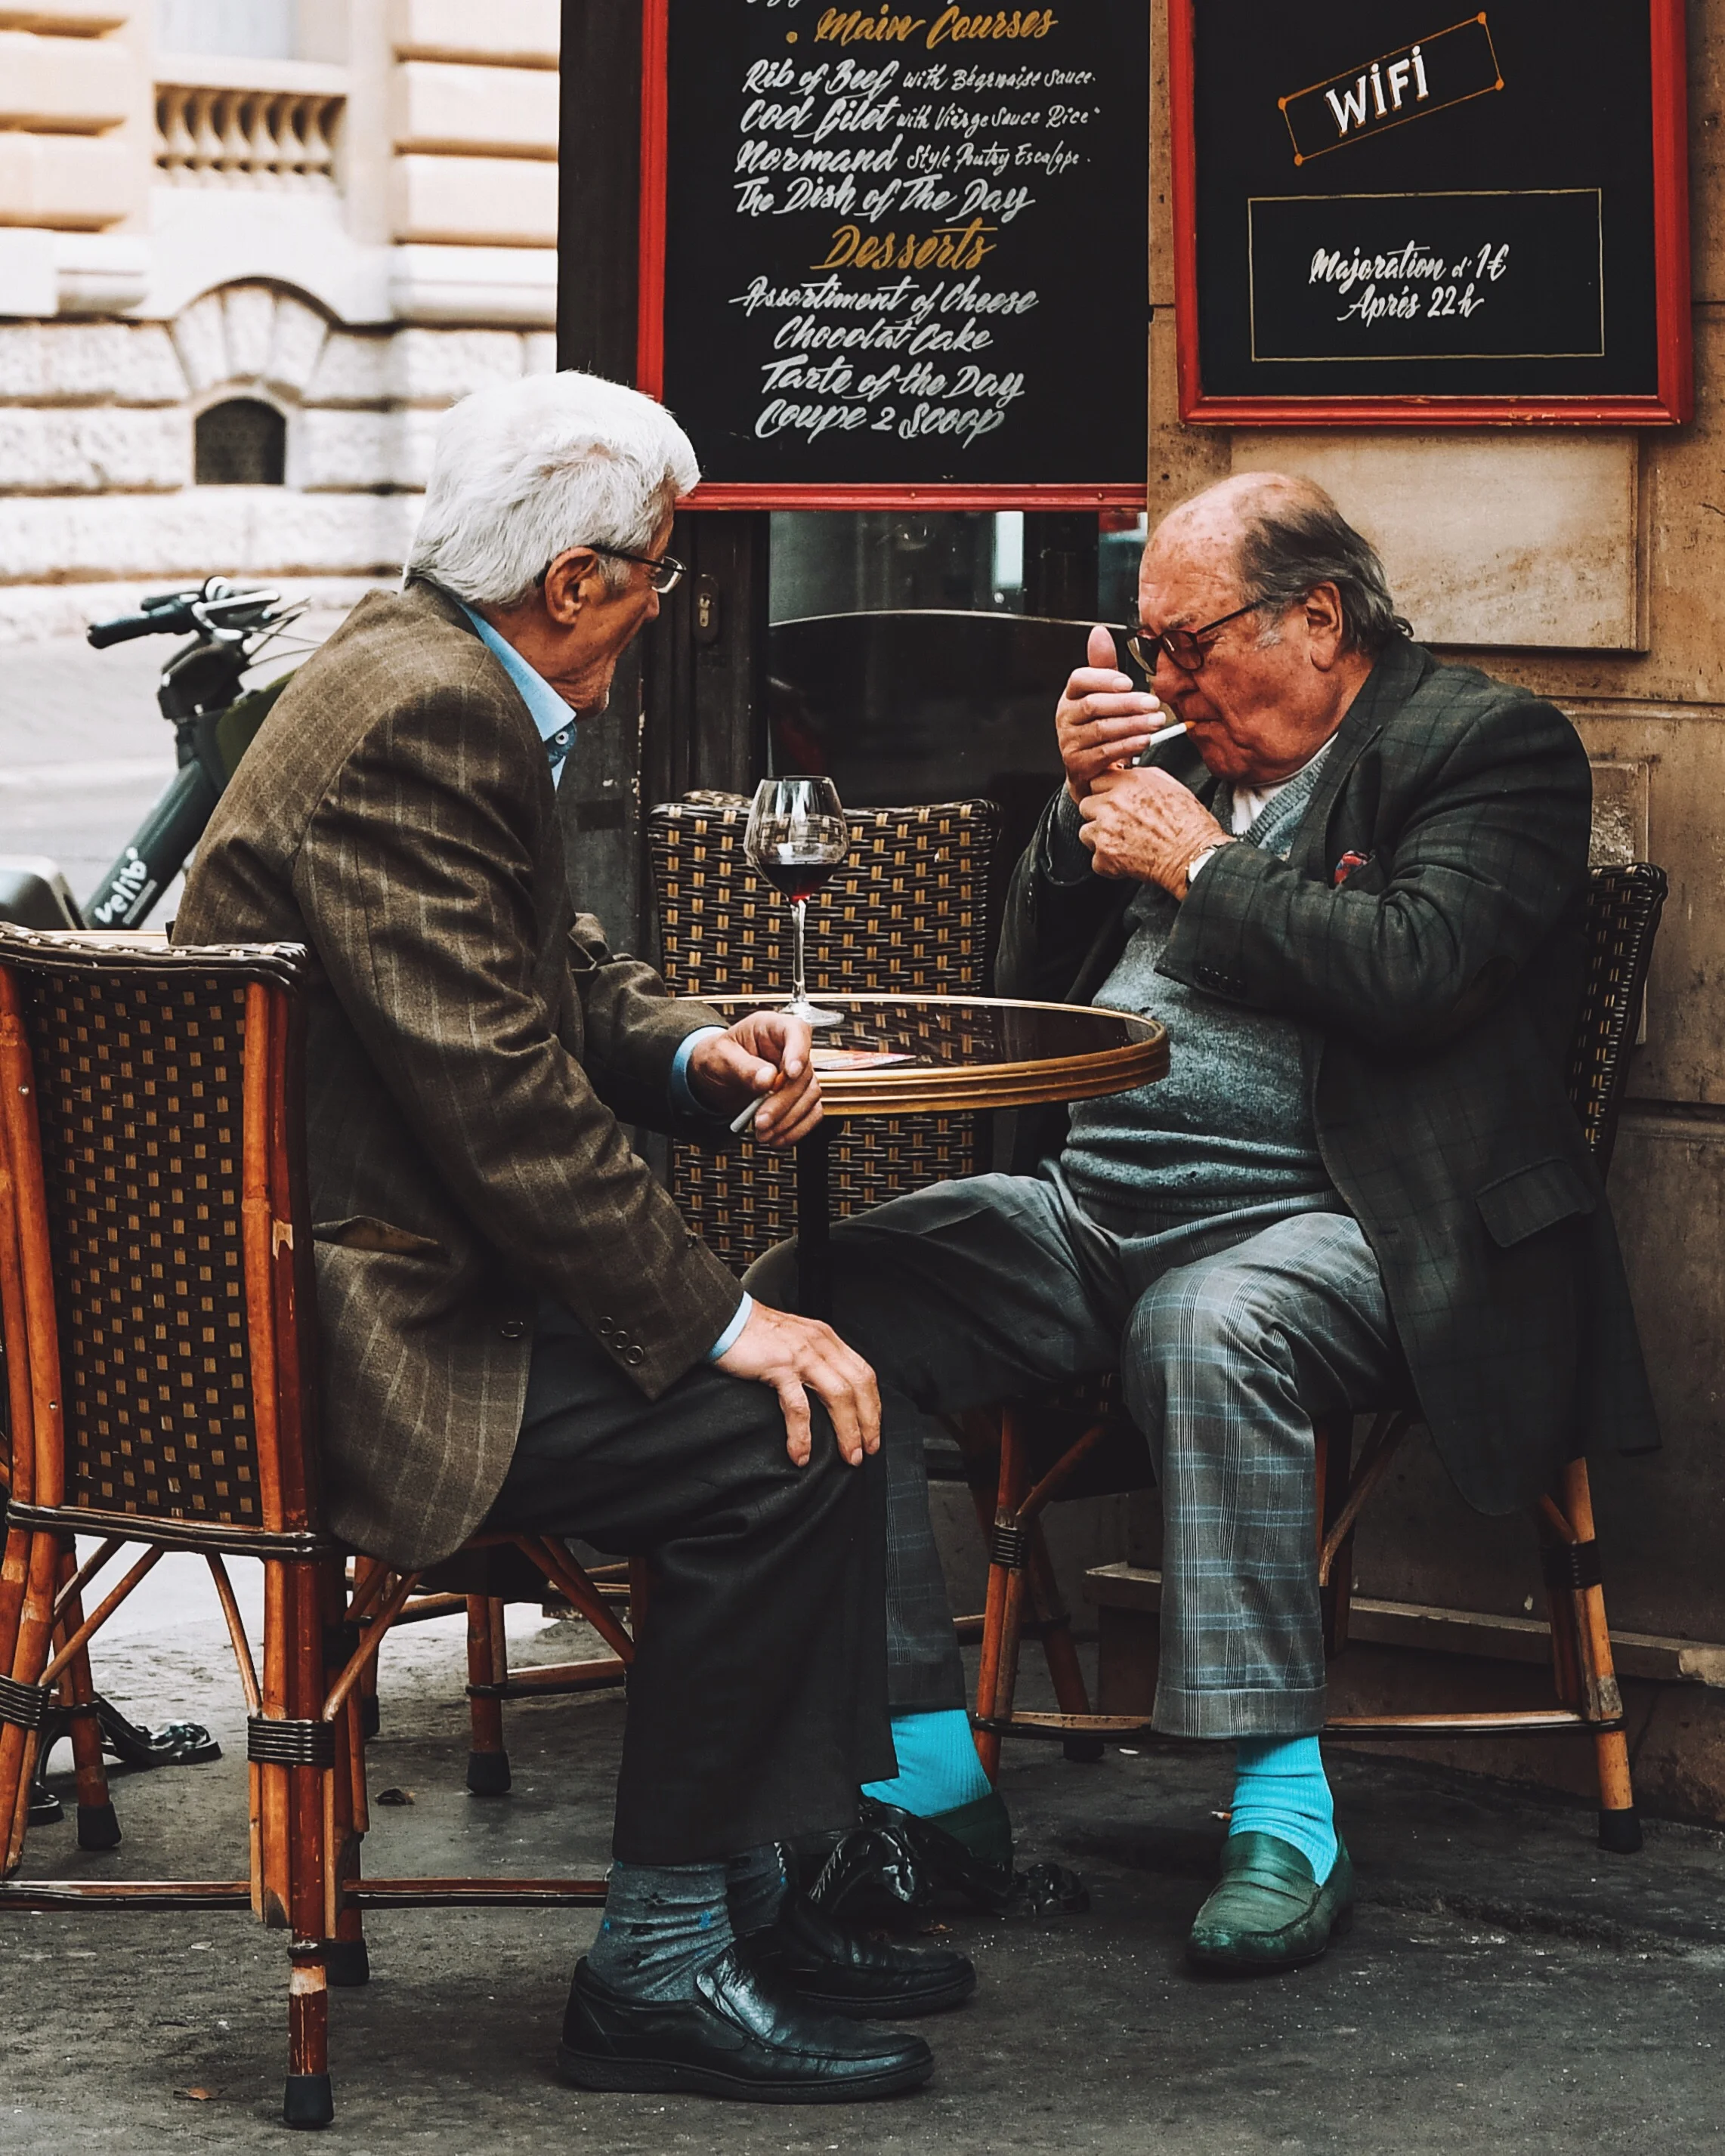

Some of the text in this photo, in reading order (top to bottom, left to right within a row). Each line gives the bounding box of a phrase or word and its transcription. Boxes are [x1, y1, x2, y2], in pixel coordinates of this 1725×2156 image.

[814, 4, 1059, 50] Main Courses
[742, 58, 794, 94] Rib
[790, 63, 830, 96] of
[824, 58, 900, 102] Beef
[903, 63, 948, 91] with
[740, 95, 815, 133] Cod
[896, 104, 930, 129] with
[991, 107, 1041, 127] Sauce
[734, 133, 904, 175] Normand
[906, 144, 951, 174] Style
[733, 175, 775, 218] The
[772, 173, 857, 216] Dish
[852, 178, 903, 224] of
[945, 178, 1037, 224] Day
[809, 217, 999, 270] Desserts
[1308, 239, 1448, 295] Majoration
[1476, 242, 1510, 282] 1€
[728, 273, 1040, 326] Assortiment of Cheese
[1427, 282, 1485, 318] 22h
[773, 314, 994, 356] Chocolat Cake
[761, 354, 1025, 409] Tarte of the Day
[755, 398, 1006, 449] Coupe 2 Scoop
